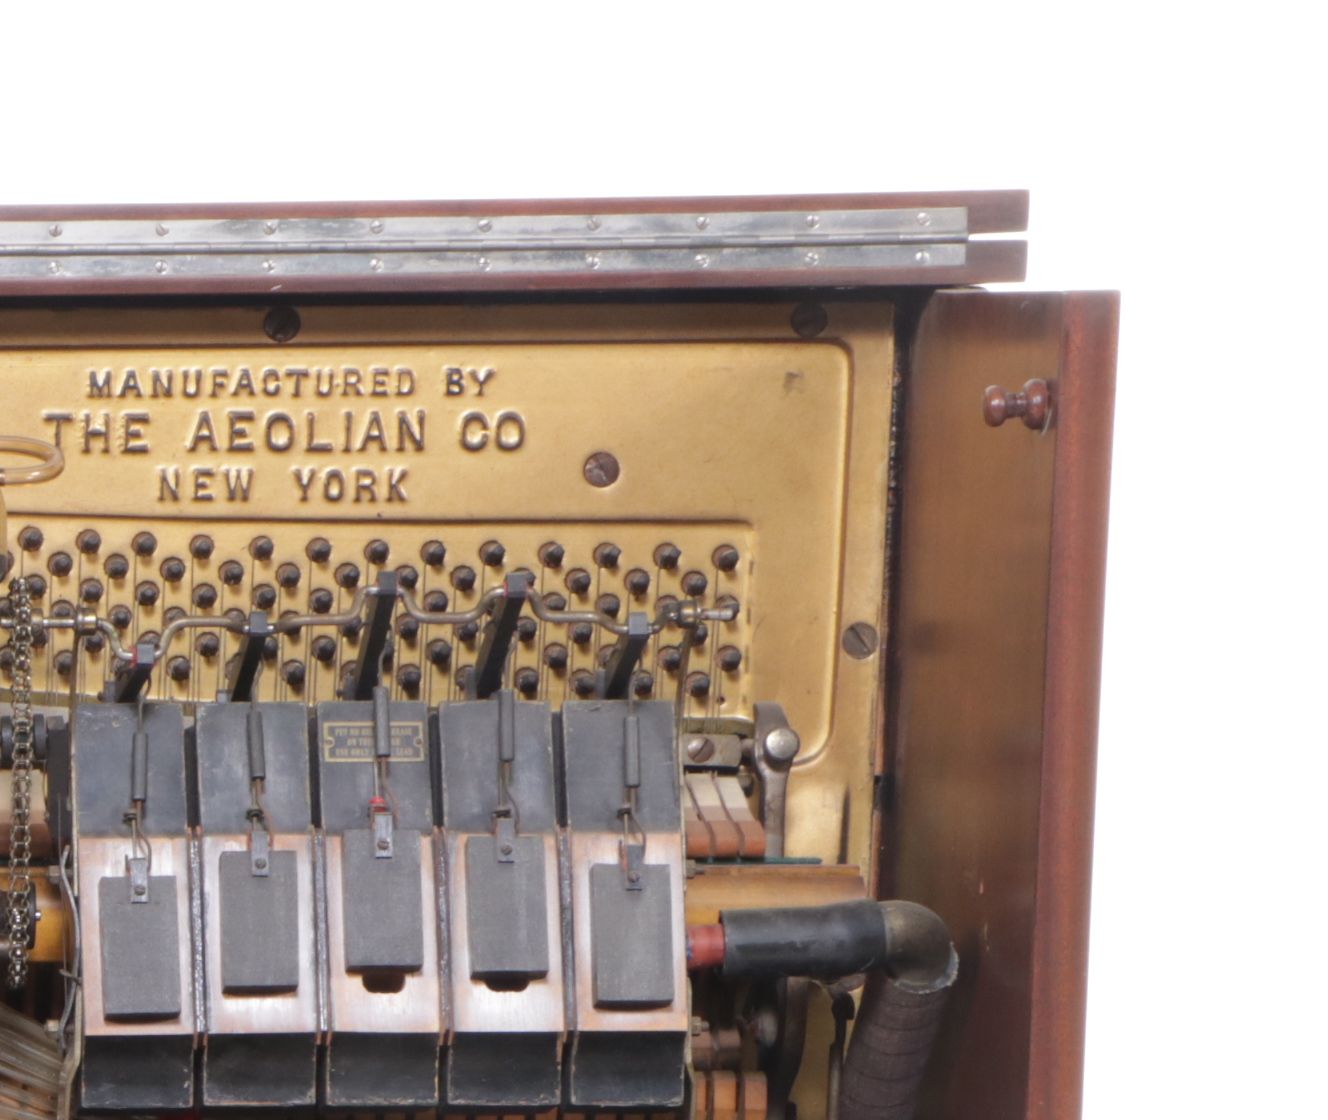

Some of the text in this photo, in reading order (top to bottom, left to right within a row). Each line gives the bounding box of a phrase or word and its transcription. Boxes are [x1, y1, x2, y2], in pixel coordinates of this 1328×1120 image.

[86, 366, 495, 399] MANUFACTURED BY
[42, 408, 527, 454] THE AEOLIAN CO
[155, 465, 410, 503] NEW YORK
